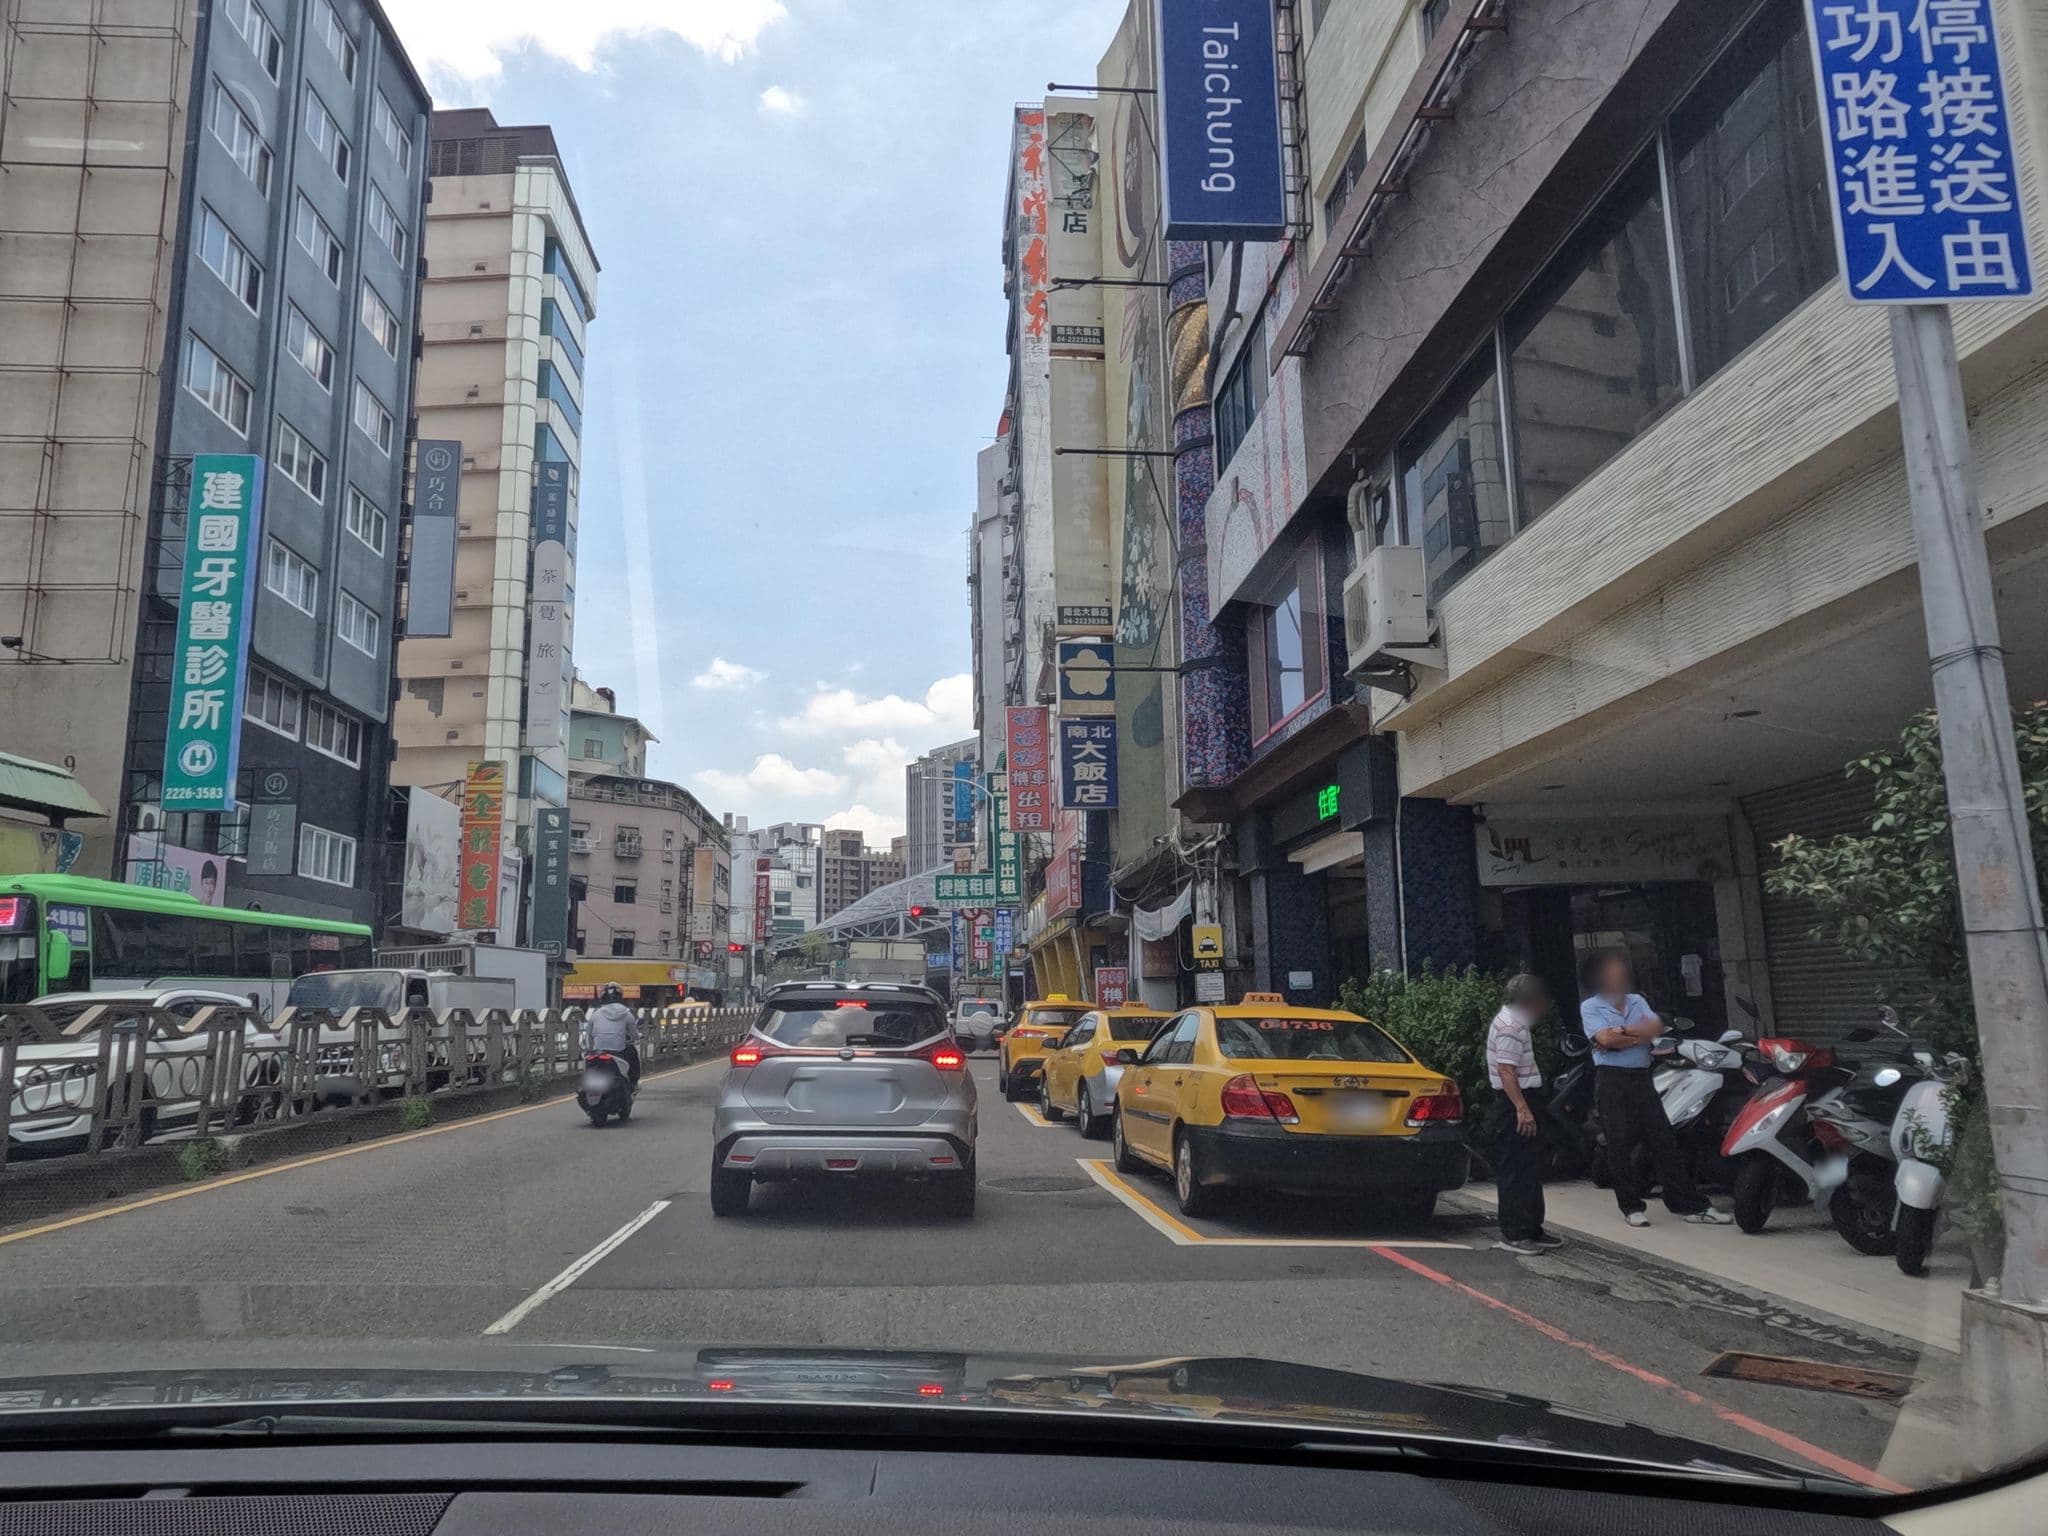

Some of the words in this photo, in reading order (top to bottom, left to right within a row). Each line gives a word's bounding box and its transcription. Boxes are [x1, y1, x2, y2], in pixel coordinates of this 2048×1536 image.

[1201, 21, 1243, 193] Taichung
[1823, 0, 1936, 291] 功路進入
[1908, 0, 2022, 291] 停接送由
[1062, 211, 1087, 234] 店
[179, 471, 244, 730] 建國牙醫診所
[537, 569, 558, 659] 茶覺旅
[1067, 725, 1112, 739] 南北
[165, 786, 224, 800] 2226-3583
[1072, 740, 1108, 804] 大飯店
[1319, 785, 1338, 820] 住宿
[1200, 959, 1220, 968] TAXI
[1250, 994, 1281, 1002] TAXI
